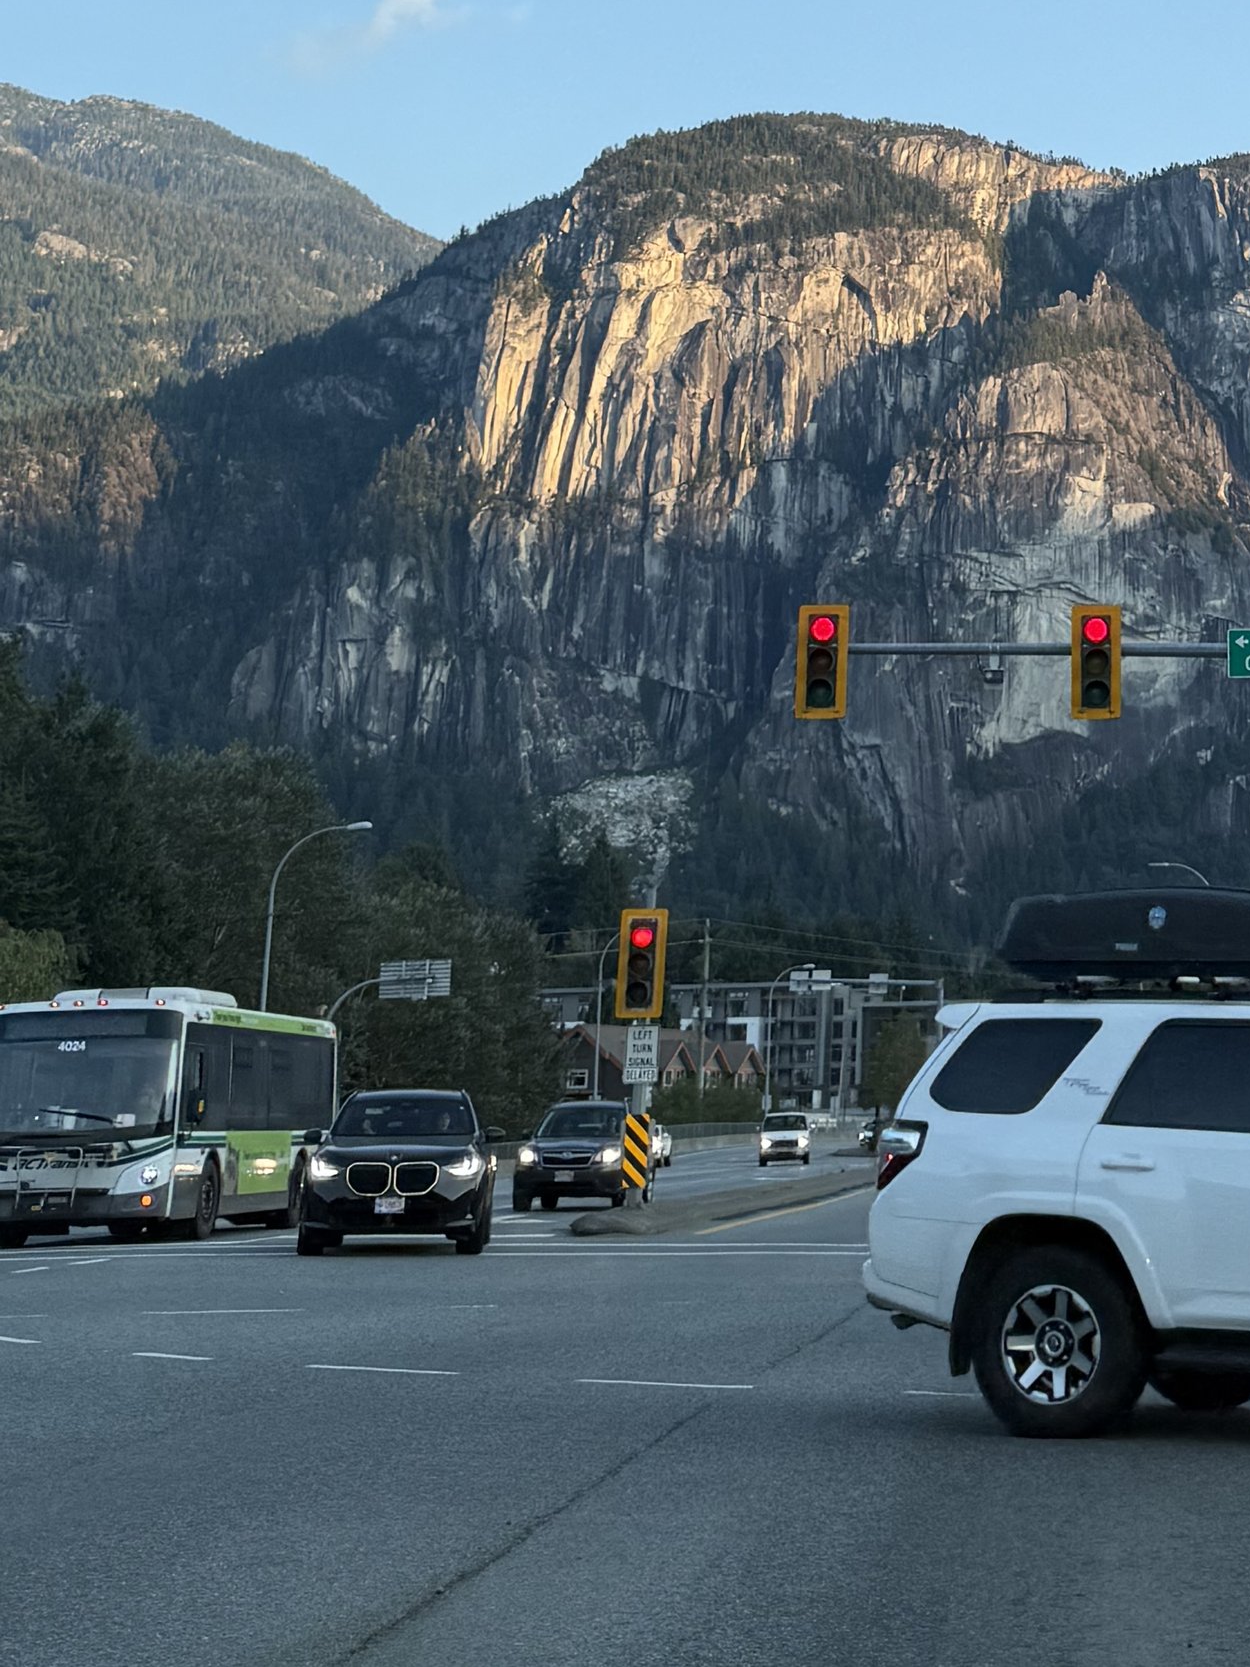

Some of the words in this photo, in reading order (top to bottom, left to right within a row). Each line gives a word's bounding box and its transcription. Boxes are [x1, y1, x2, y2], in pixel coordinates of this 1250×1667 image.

[632, 1030, 652, 1040] LEFT
[58, 1040, 86, 1052] 4024
[632, 1044, 652, 1053] TURN
[628, 1057, 655, 1066] SIGNAL
[626, 1069, 656, 1081] DELAYED
